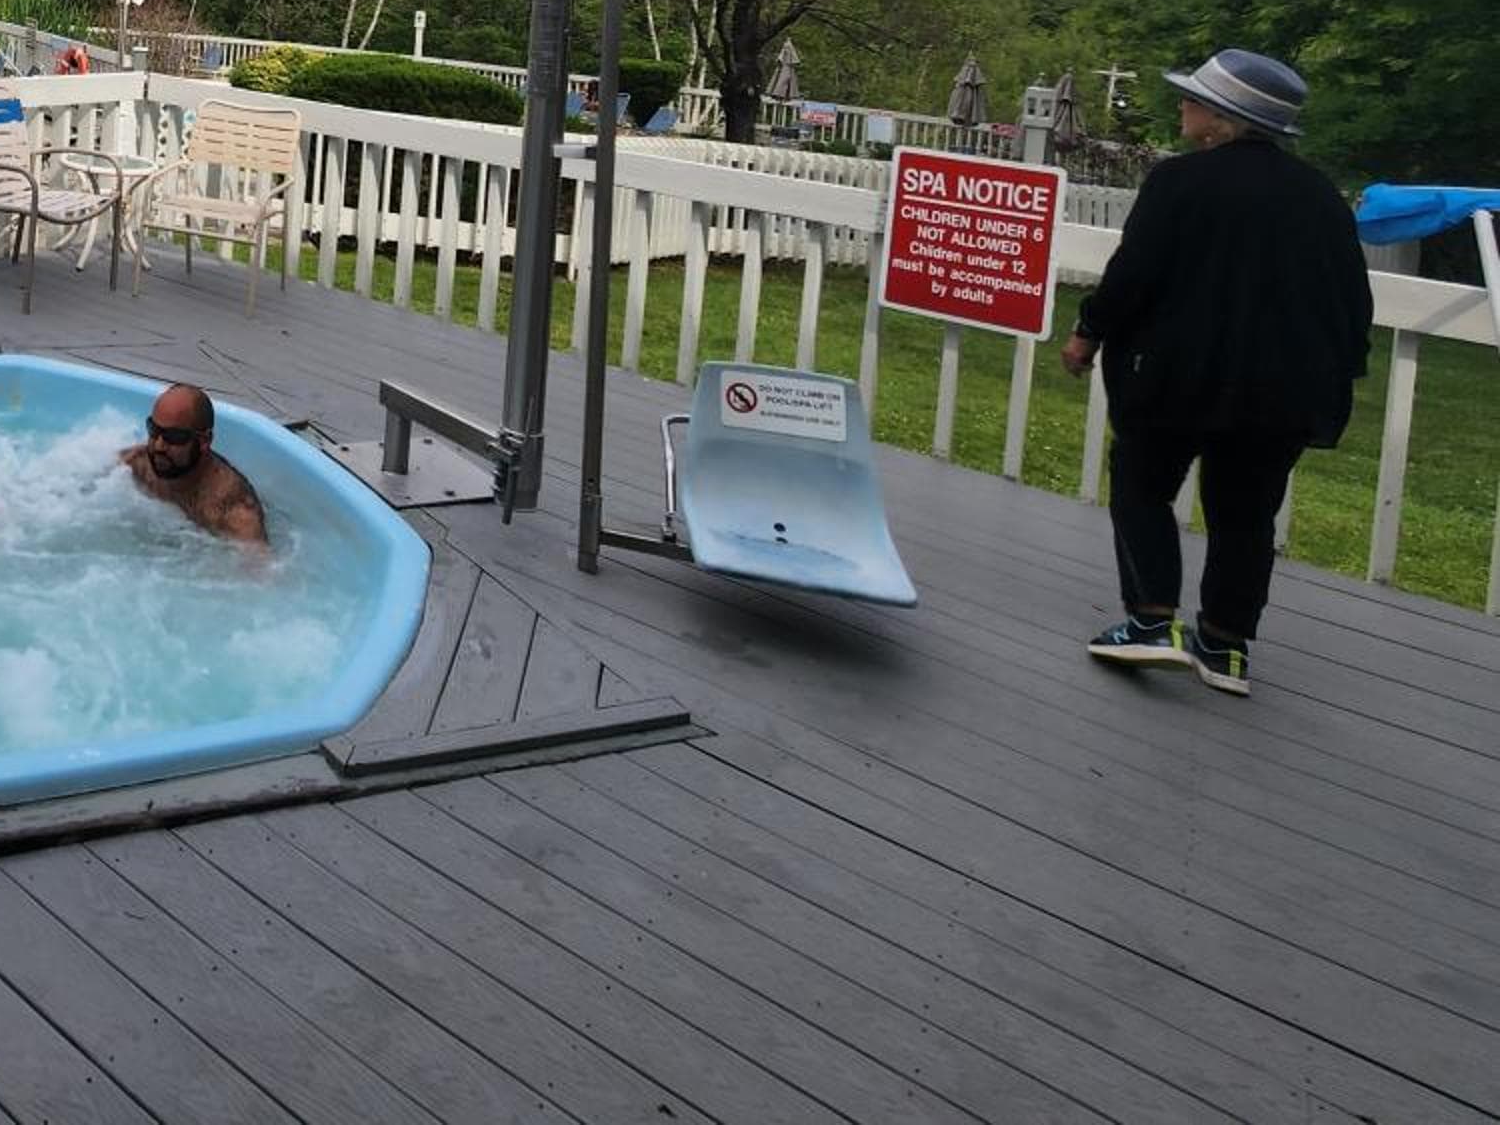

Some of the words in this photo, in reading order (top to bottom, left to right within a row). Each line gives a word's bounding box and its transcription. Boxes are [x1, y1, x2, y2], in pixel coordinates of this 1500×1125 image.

[902, 168, 947, 197] SPA
[956, 175, 1050, 212] NOTICE
[900, 205, 971, 229] CHILDREN
[975, 217, 1027, 239] UNDER
[1033, 228, 1044, 242] 6
[917, 225, 946, 242] NOT
[951, 232, 1022, 256] ALLOWED
[909, 240, 963, 263] Children
[967, 253, 1005, 271] under
[1011, 260, 1027, 276] 12
[891, 257, 923, 273] must
[928, 261, 945, 277] be
[949, 267, 1043, 296] accompanied
[931, 280, 948, 297] by
[952, 285, 994, 305] adults
